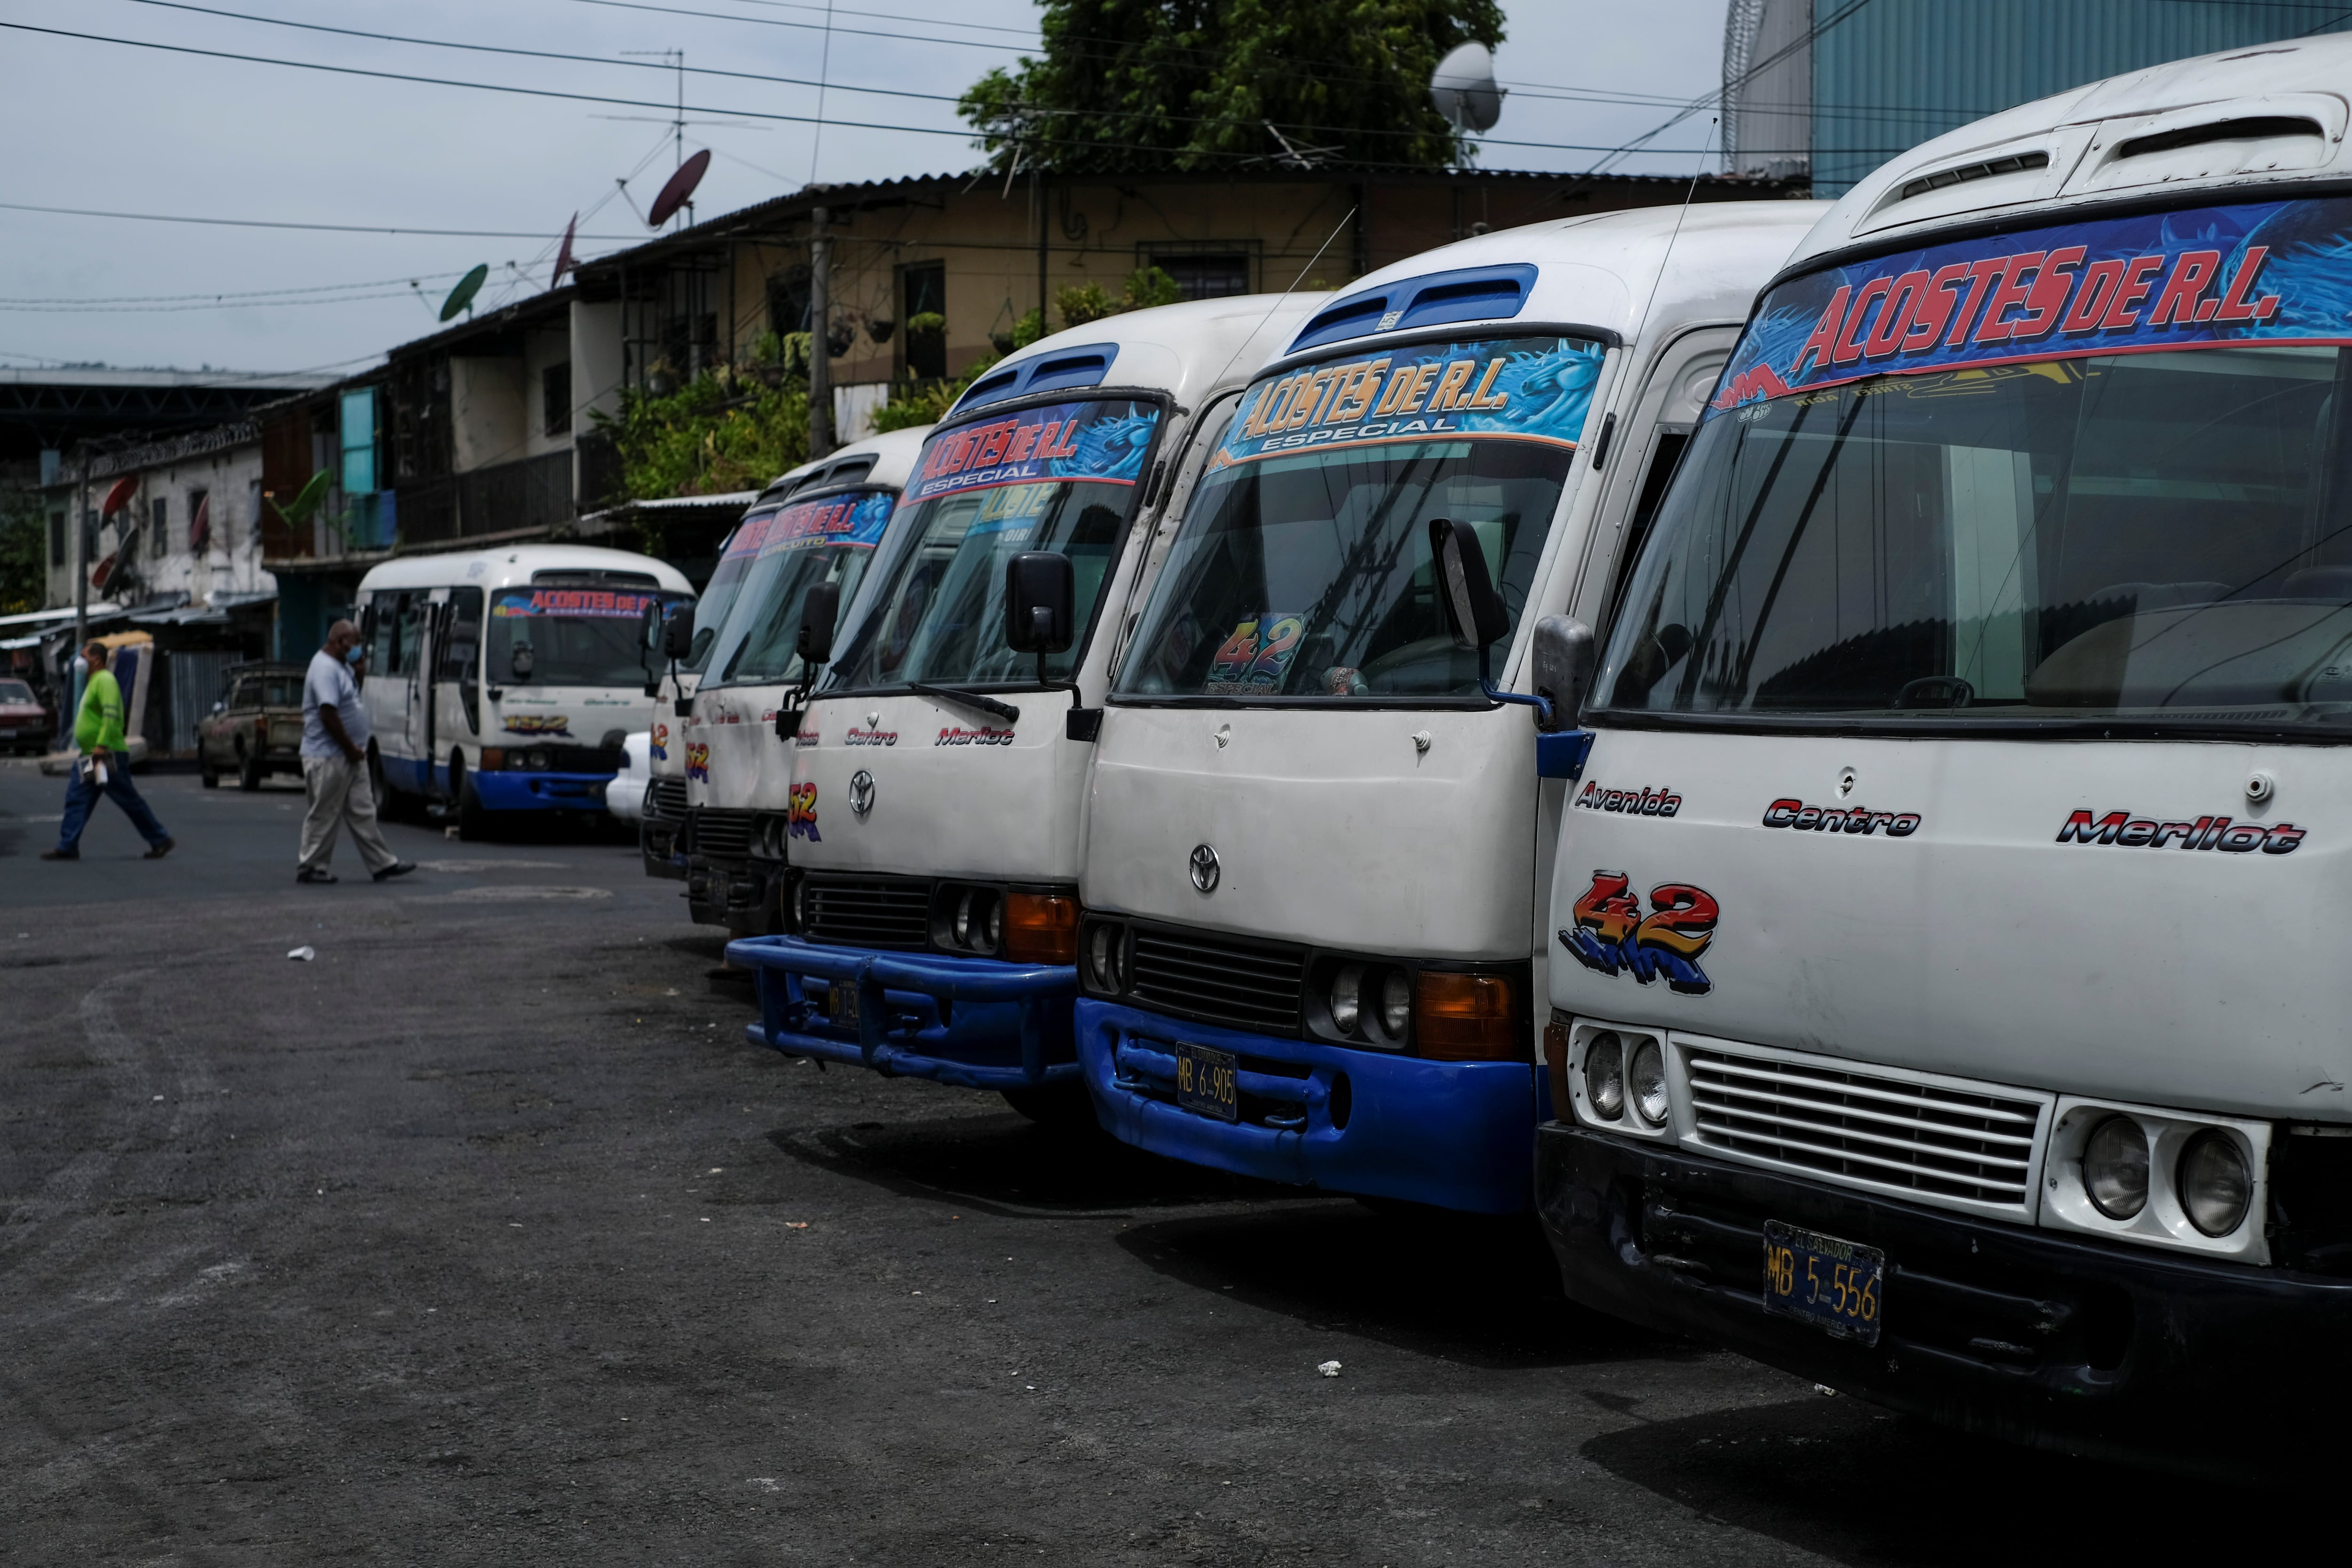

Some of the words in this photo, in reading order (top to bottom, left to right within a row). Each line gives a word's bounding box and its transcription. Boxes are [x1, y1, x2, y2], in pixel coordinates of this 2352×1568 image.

[1790, 245, 2088, 373] ACOSTES
[2059, 255, 2165, 333] DE
[2146, 245, 2281, 326] R.L.
[1233, 358, 1392, 444] ACOSTES
[1372, 363, 1443, 418] DE
[1425, 358, 1509, 412] R.L.
[915, 419, 1019, 483] ACOSTES
[1003, 423, 1043, 463] DE
[1032, 420, 1078, 459] R.L.
[1261, 418, 1456, 452] ESPECIAL
[921, 465, 1036, 495] ESPECIAL
[766, 501, 818, 544] ACOSTES
[807, 506, 832, 535] DE
[763, 538, 826, 556] CIRCUITO
[530, 591, 615, 608] ACOSTES
[616, 597, 636, 610] DE
[1214, 618, 1302, 681] 42
[1205, 682, 1277, 695] ESPECIAL
[504, 716, 568, 732] 152
[844, 727, 898, 746] Centro
[934, 726, 1015, 746] Merliot
[1575, 780, 1682, 817] Avenida
[1763, 798, 1922, 837] Centro
[2056, 810, 2306, 855] Merliot
[1573, 873, 1720, 964] 42
[1178, 1056, 1193, 1092] MB
[1795, 1233, 1805, 1249] EL
[1806, 1234, 1853, 1262] SALVADOR
[1767, 1243, 1795, 1297] MB
[1788, 1305, 1815, 1322] CENTRO
[1817, 1315, 1846, 1330] AMERICA
